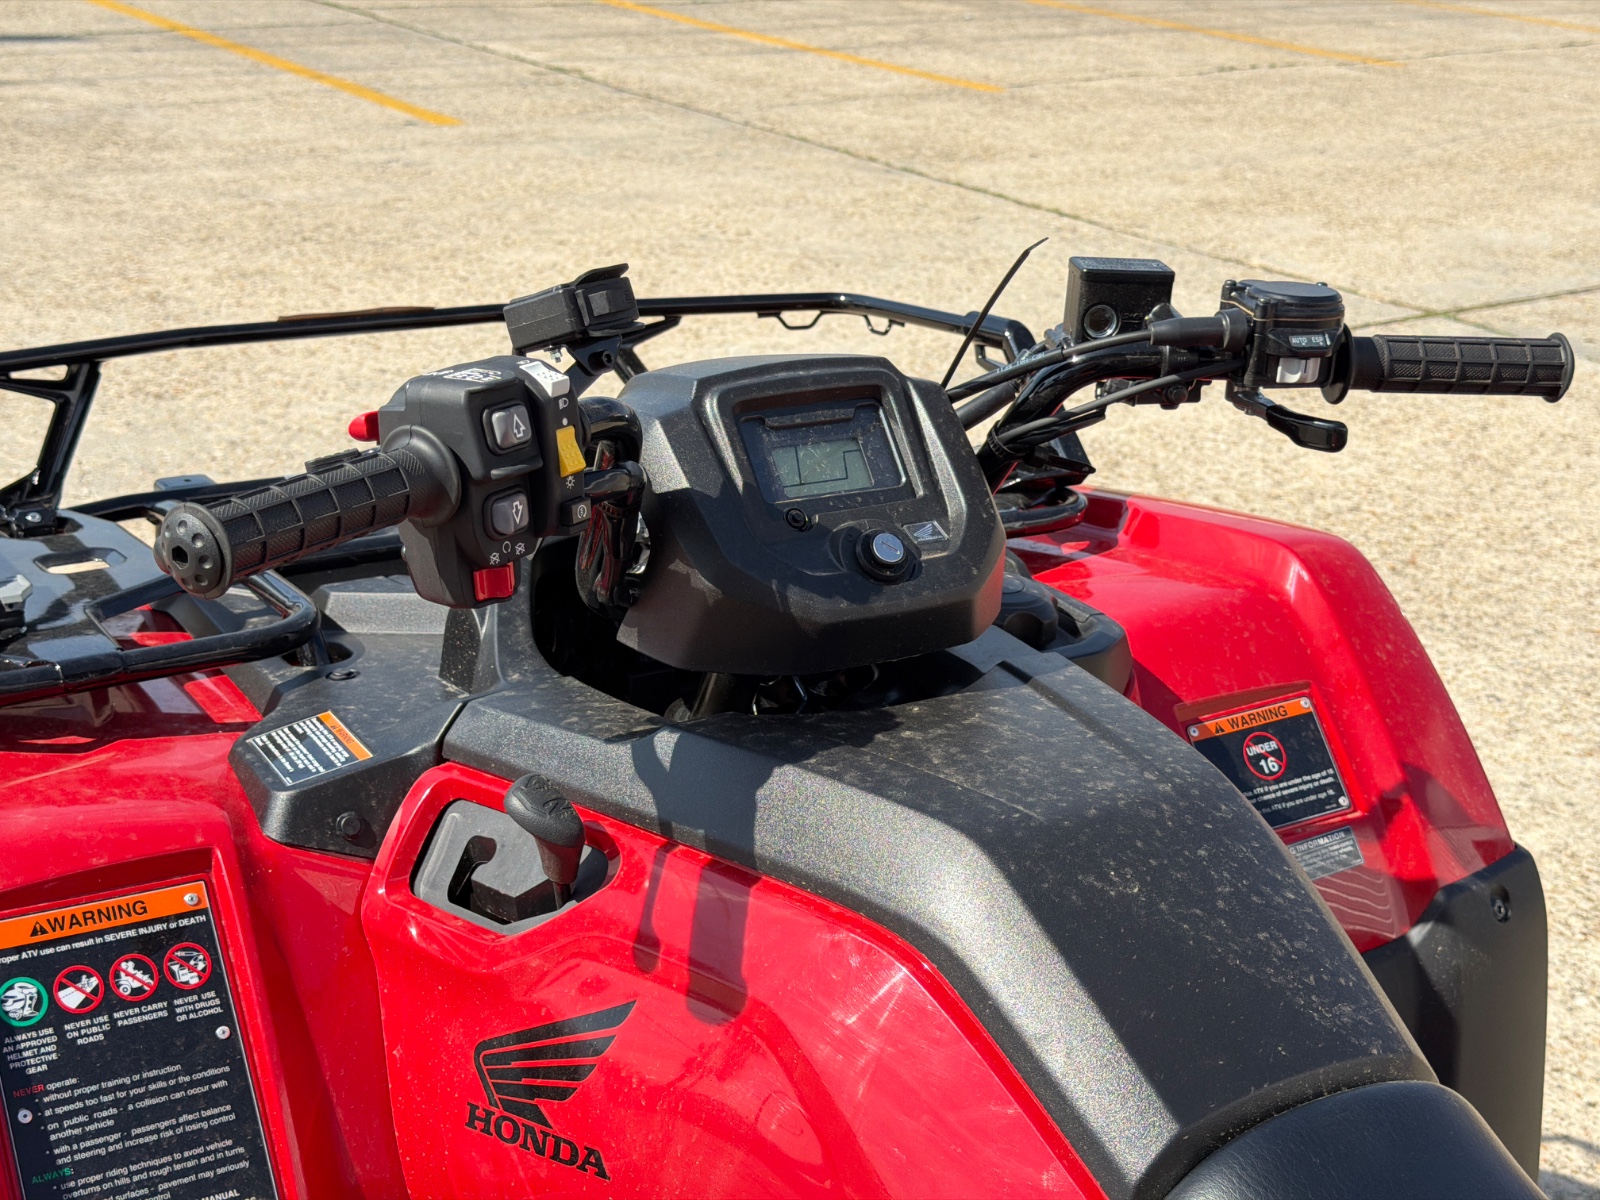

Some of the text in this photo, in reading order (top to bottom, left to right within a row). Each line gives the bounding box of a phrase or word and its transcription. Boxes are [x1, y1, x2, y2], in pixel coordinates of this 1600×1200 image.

[1226, 705, 1288, 730] WARNING
[1246, 740, 1278, 756] UNDER
[1258, 756, 1280, 774] 16
[1296, 831, 1346, 852] INFORMATION
[46, 900, 148, 933] WARNING
[22, 949, 38, 960] ATV
[40, 947, 55, 956] use
[56, 944, 71, 953] can
[72, 938, 94, 948] result
[96, 936, 104, 944] in
[104, 928, 138, 943] SEVERE
[138, 922, 168, 935] INJURY
[178, 914, 206, 927] DEATH
[173, 990, 217, 1006] NEVER USE
[175, 998, 221, 1014] WITH DRUGS
[113, 1001, 168, 1019] NEVER CARRY
[117, 1010, 168, 1027] PASSENGERS
[176, 1006, 224, 1022] OR ALCOHOL
[64, 1015, 110, 1030] NEVER USE
[66, 1023, 111, 1039] ON PUBLIC
[4, 1027, 54, 1044] ALWAYS USE
[76, 1034, 104, 1046] ROADS
[2, 1036, 58, 1054] AN APPROVED
[7, 1044, 57, 1062] HELMET AND
[9, 1052, 58, 1070] PROTECTIVE
[26, 1064, 48, 1075] GEAR
[13, 1076, 80, 1098] NEVER operate:
[42, 1063, 182, 1103] without proper training or instruction
[44, 1065, 230, 1117] at speeds too fast for your skills or the conditions
[47, 1122, 60, 1131] on
[63, 1114, 89, 1128] public
[93, 1107, 118, 1119] roads
[135, 1094, 168, 1109] collision
[170, 1090, 186, 1100] can
[187, 1084, 209, 1095] occur
[211, 1079, 228, 1090] with
[49, 1119, 115, 1141] another vehicle
[53, 1145, 71, 1155] with
[80, 1132, 122, 1150] passenger
[131, 1118, 177, 1137] passengers
[178, 1111, 200, 1124] affect
[201, 1104, 232, 1117] balance
[56, 1112, 236, 1165] and steering and increase risk of losing control
[465, 1102, 611, 1182] HONDA
[61, 1138, 233, 1190] use proper riding techniques to avoid vehicle
[63, 1184, 101, 1200] overturns
[102, 1182, 113, 1190] on
[114, 1176, 131, 1187] hills
[132, 1171, 148, 1182] and
[149, 1165, 172, 1176] rough
[173, 1160, 199, 1171] terrain
[200, 1154, 215, 1164] and
[216, 1151, 224, 1159] in
[225, 1146, 245, 1157] turns
[32, 1167, 74, 1184] ALWAYS:
[115, 1187, 149, 1200] surfaces
[158, 1174, 196, 1192] pavement
[198, 1169, 214, 1179] may
[216, 1160, 250, 1175] seriously
[145, 1190, 171, 1200] ntrol
